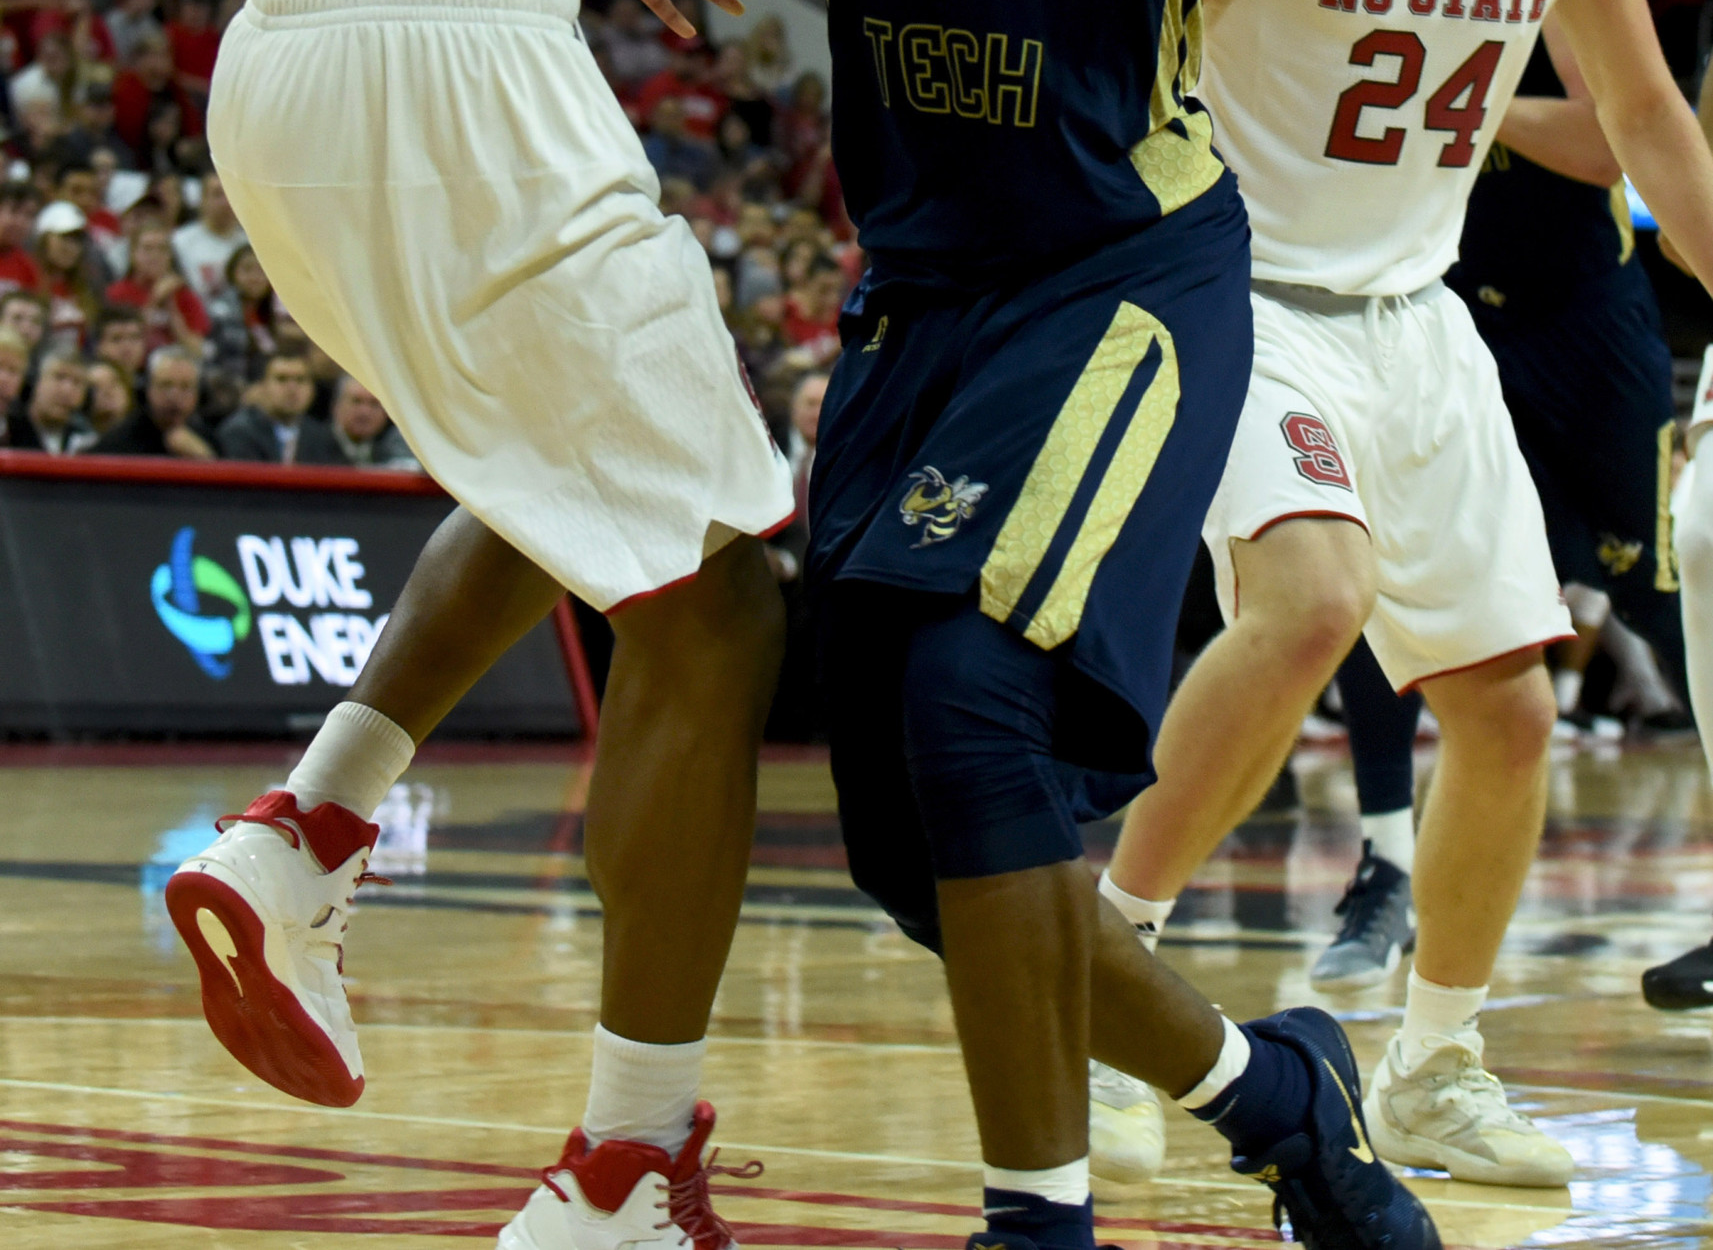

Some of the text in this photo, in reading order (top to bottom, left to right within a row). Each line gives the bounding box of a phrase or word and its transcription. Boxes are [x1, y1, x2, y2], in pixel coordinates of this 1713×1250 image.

[864, 16, 1043, 128] TECH
[1323, 28, 1506, 168] 24
[237, 535, 374, 609] DUKE
[258, 611, 391, 687] ENER
